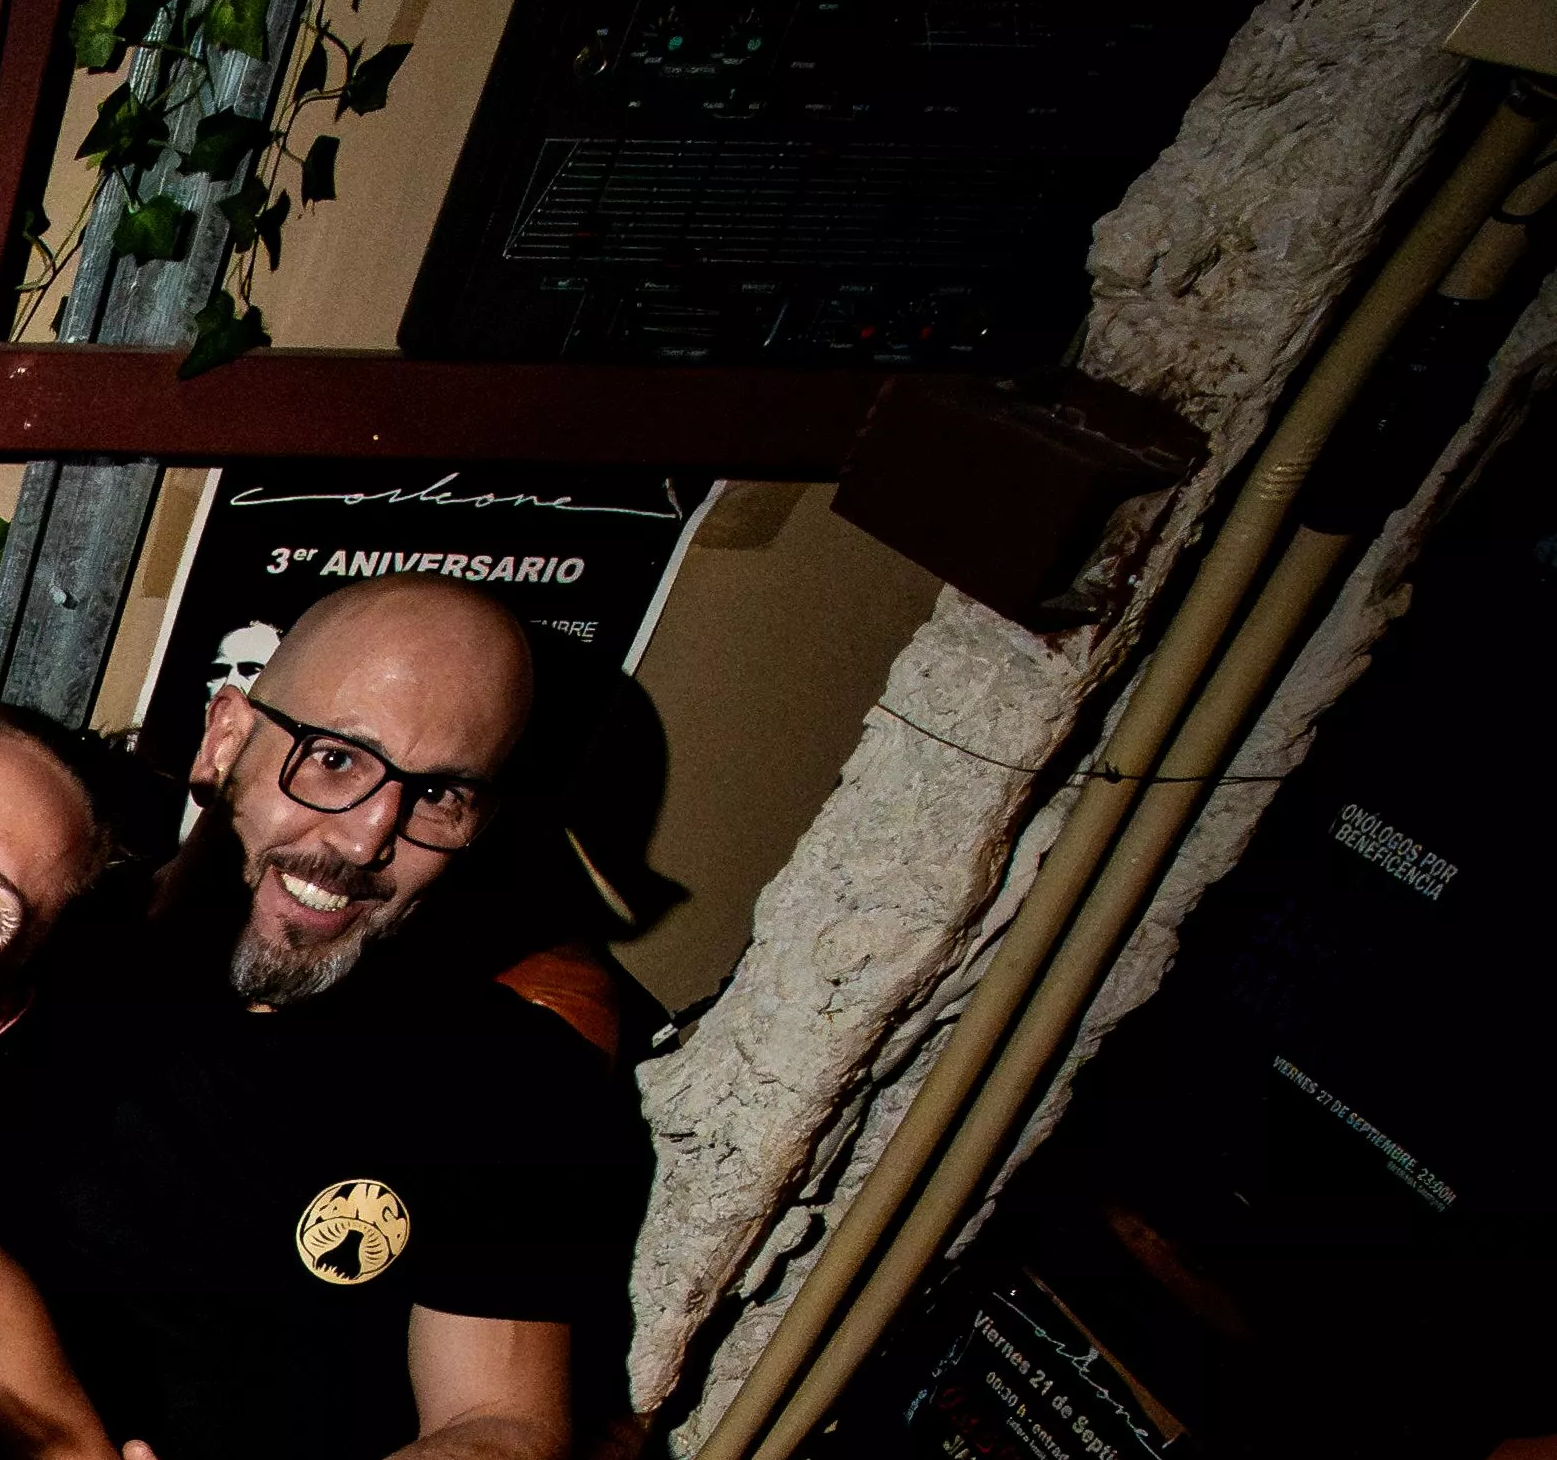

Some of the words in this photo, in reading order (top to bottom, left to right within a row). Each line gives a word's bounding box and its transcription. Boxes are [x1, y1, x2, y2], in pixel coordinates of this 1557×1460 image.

[320, 549, 586, 584] ANIVERSARIO
[1335, 824, 1443, 900] BENEFICENCIA
[1342, 804, 1422, 862] ONÓLOGOS
[1420, 852, 1458, 883] POR
[1273, 1056, 1318, 1093] VIERNES
[1316, 1090, 1333, 1105] 27
[1330, 1100, 1350, 1118] DE
[974, 1310, 1030, 1374] Viernes
[1029, 1370, 1053, 1395] 21
[1052, 1396, 1072, 1418] de
[986, 1372, 1018, 1407] 00:30
